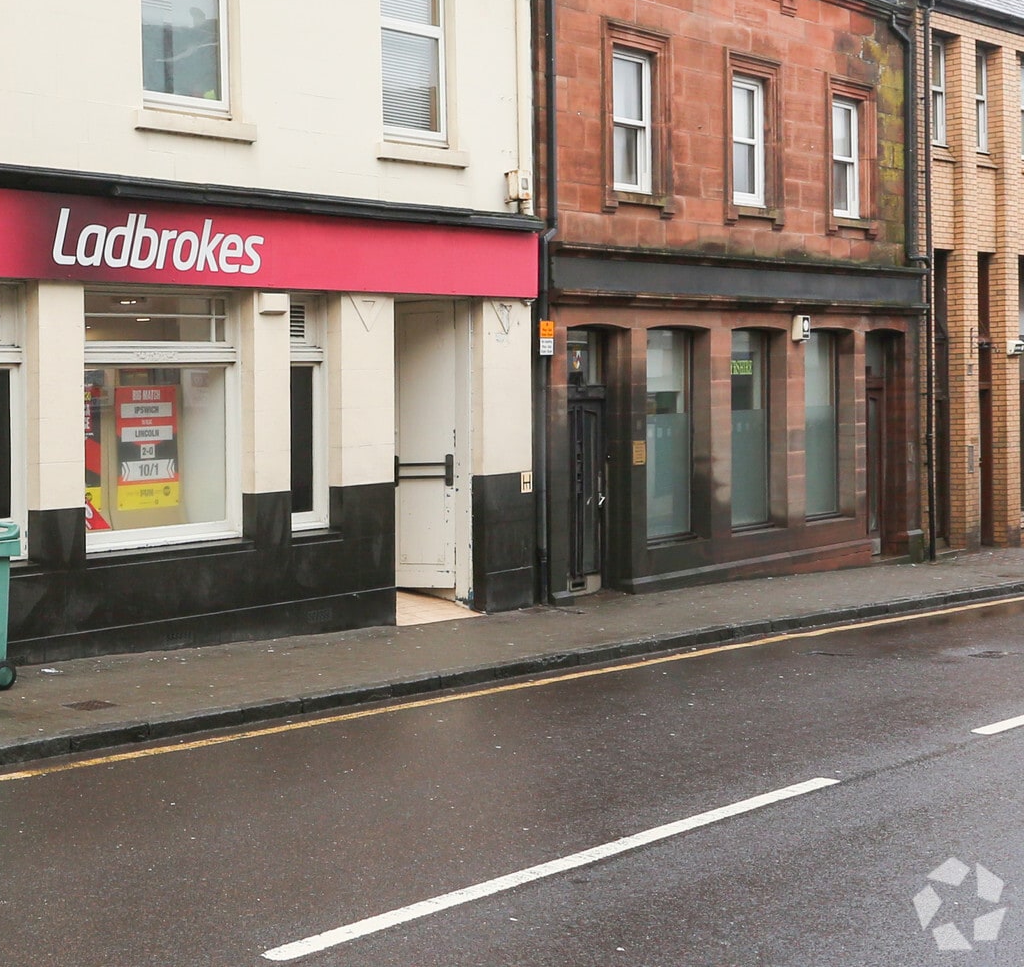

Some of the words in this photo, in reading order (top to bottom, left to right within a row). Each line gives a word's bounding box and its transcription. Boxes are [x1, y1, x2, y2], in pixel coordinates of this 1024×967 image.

[52, 207, 265, 275] Ladbrokes
[134, 406, 160, 414] IPSWICH
[135, 429, 160, 438] LINCOLN
[142, 446, 154, 456] 2-0
[138, 463, 159, 477] 10/1
